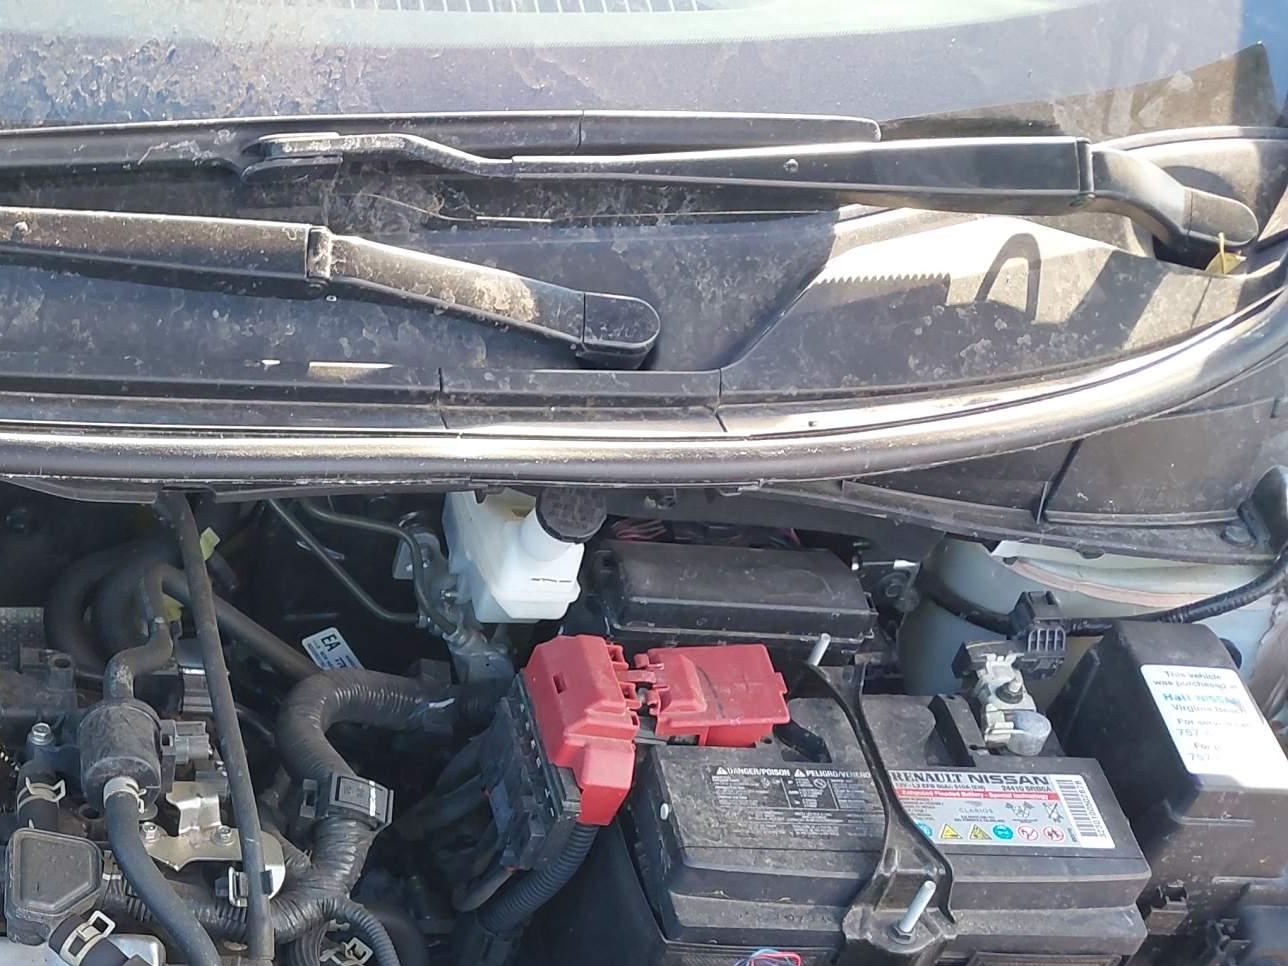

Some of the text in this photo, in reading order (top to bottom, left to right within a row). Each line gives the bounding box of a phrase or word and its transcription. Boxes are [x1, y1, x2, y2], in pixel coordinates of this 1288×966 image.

[320, 633, 342, 652] EA
[892, 771, 1049, 786] RENAULT NISSAN
